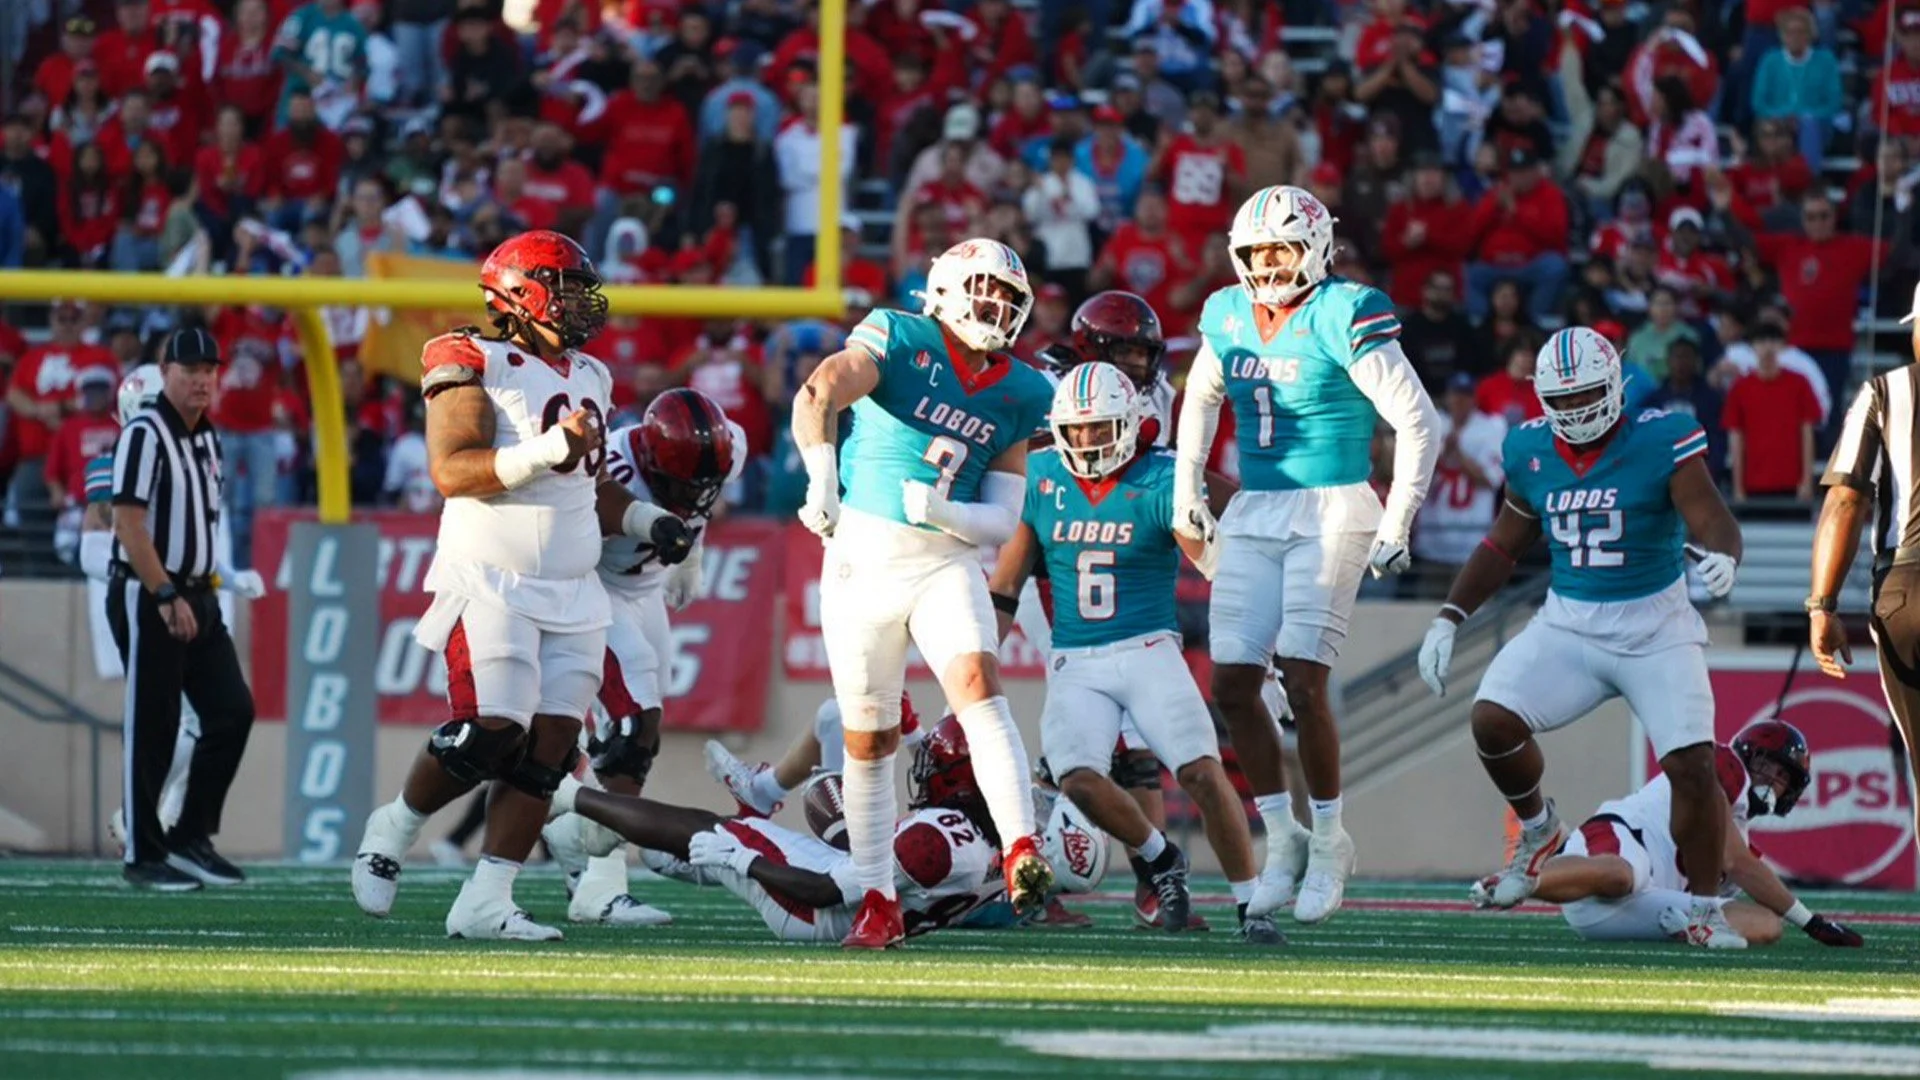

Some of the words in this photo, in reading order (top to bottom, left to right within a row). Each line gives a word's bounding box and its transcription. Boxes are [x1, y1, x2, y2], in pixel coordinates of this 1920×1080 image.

[928, 361, 943, 388] C
[1231, 355, 1299, 383] LOBOS
[913, 395, 997, 445] LOBOS
[1254, 386, 1273, 448] 1
[1055, 485, 1067, 511] C
[1545, 487, 1618, 513] LOBOS
[1053, 520, 1134, 545] LOBOS
[1550, 509, 1626, 567] 42
[1077, 550, 1116, 621] 6
[300, 536, 348, 864] LOBOS
[1796, 771, 1910, 810] PSI
[936, 813, 976, 848] 82
